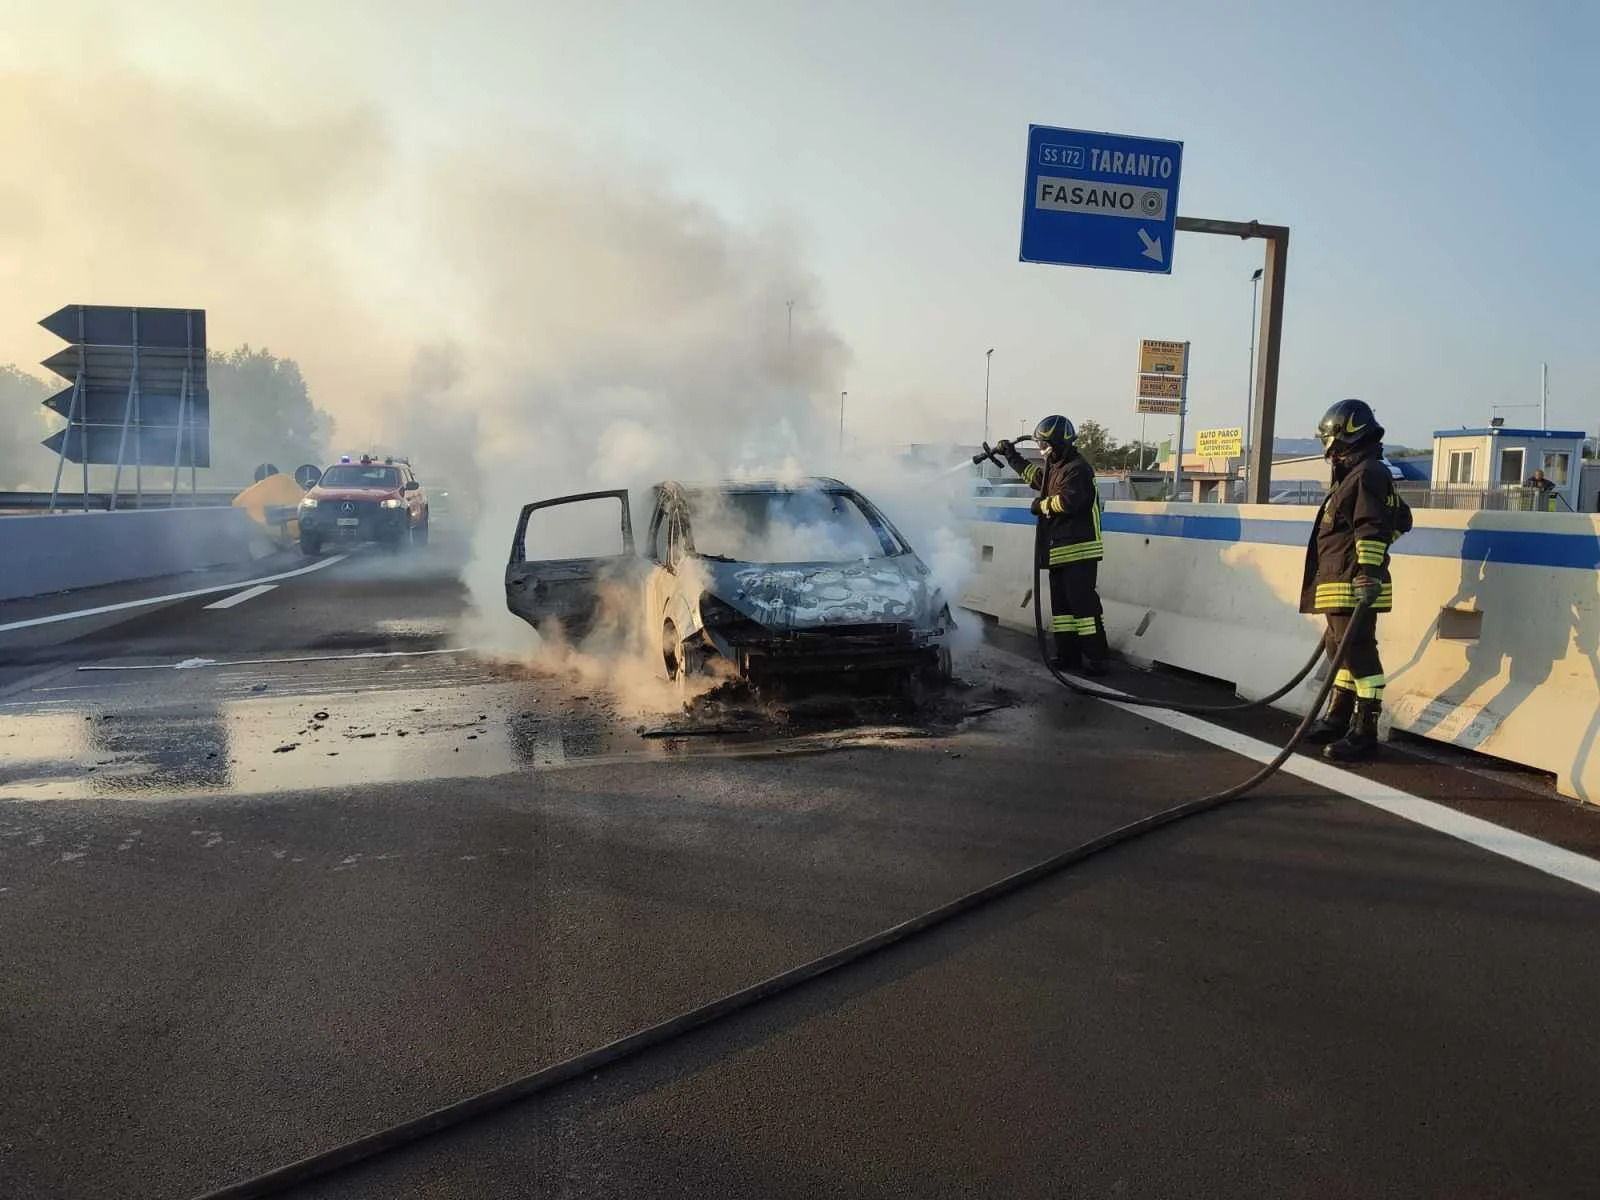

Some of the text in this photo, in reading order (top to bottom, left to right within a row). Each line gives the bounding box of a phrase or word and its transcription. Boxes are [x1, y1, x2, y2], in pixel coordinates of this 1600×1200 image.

[1044, 148, 1080, 165] SS 172
[1091, 148, 1172, 179] TARANTO
[1041, 184, 1135, 210] FASANO
[1200, 430, 1239, 439] AUTO PARCO
